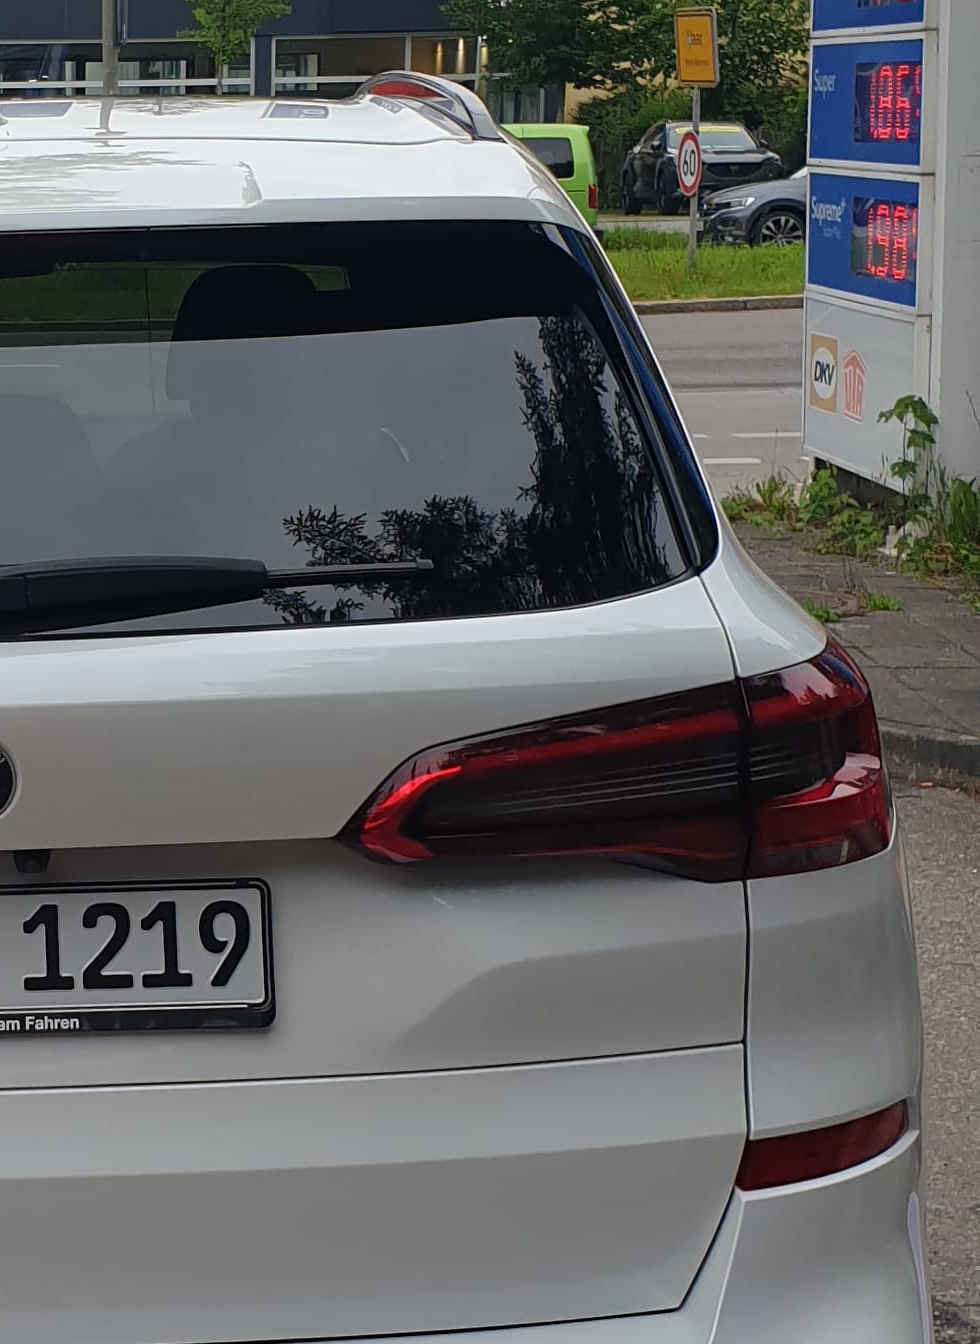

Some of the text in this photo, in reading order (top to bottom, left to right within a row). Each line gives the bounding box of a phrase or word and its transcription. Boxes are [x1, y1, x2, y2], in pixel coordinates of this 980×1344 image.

[814, 68, 837, 99] Super
[682, 149, 696, 177] 60
[814, 360, 835, 386] DKV
[22, 900, 252, 991] 1219
[24, 1015, 80, 1032] Fahren
